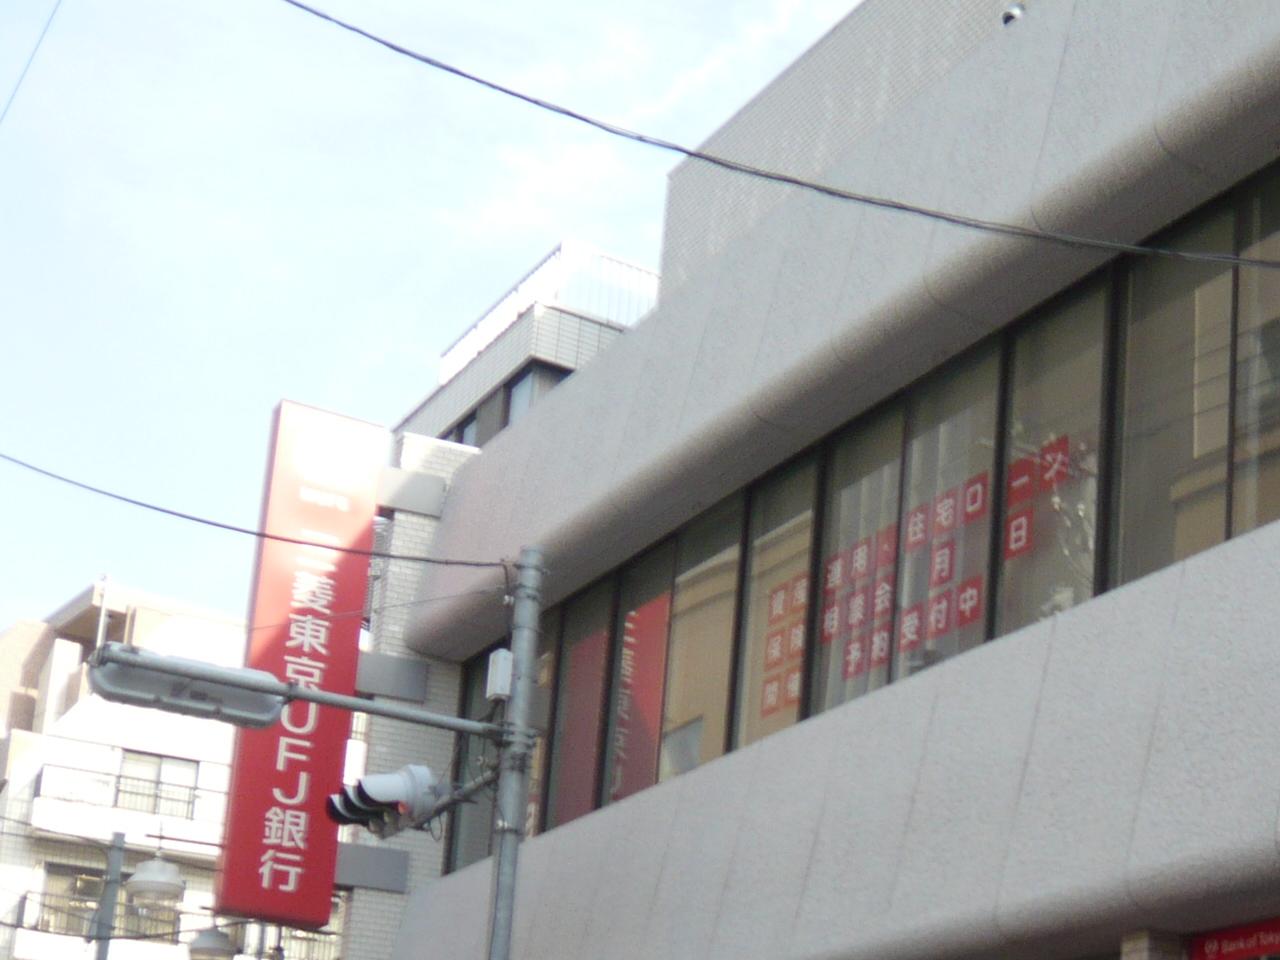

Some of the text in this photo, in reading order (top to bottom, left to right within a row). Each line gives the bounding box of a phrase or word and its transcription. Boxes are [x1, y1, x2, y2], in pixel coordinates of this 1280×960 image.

[1010, 516, 1028, 550] 日
[257, 528, 338, 893] 三菱東京UFJ銀行
